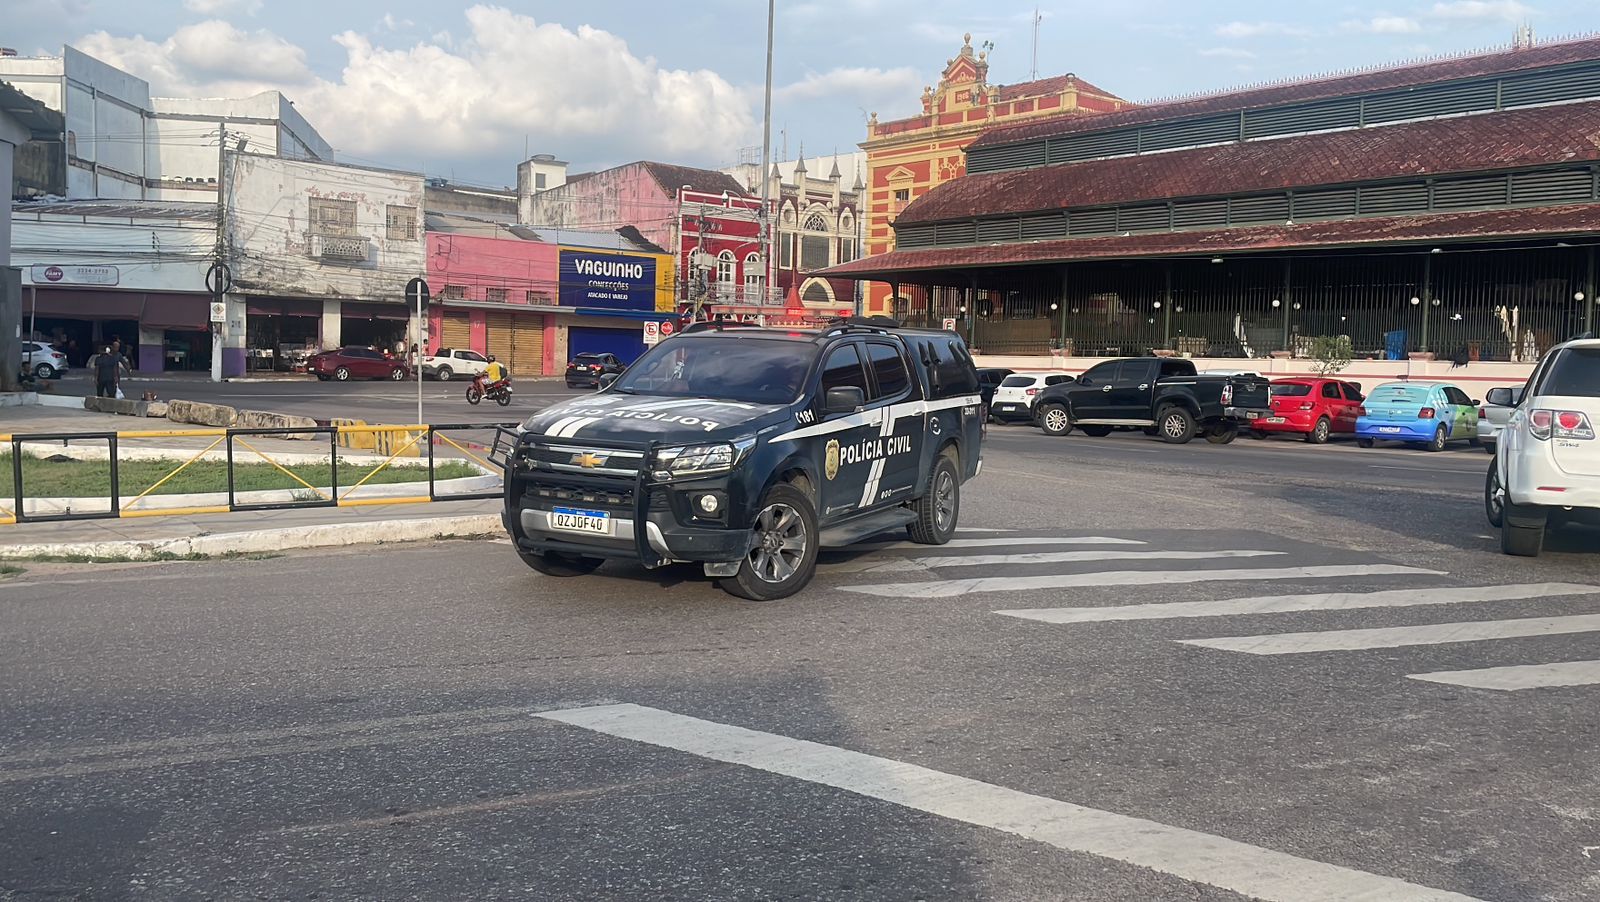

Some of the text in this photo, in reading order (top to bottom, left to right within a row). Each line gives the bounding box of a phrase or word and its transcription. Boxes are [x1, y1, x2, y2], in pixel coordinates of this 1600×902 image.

[575, 259, 643, 279] VAGUINHO
[588, 280, 629, 291] CONFECÇÕES
[840, 435, 911, 466] POLÍCIA CIVIL
